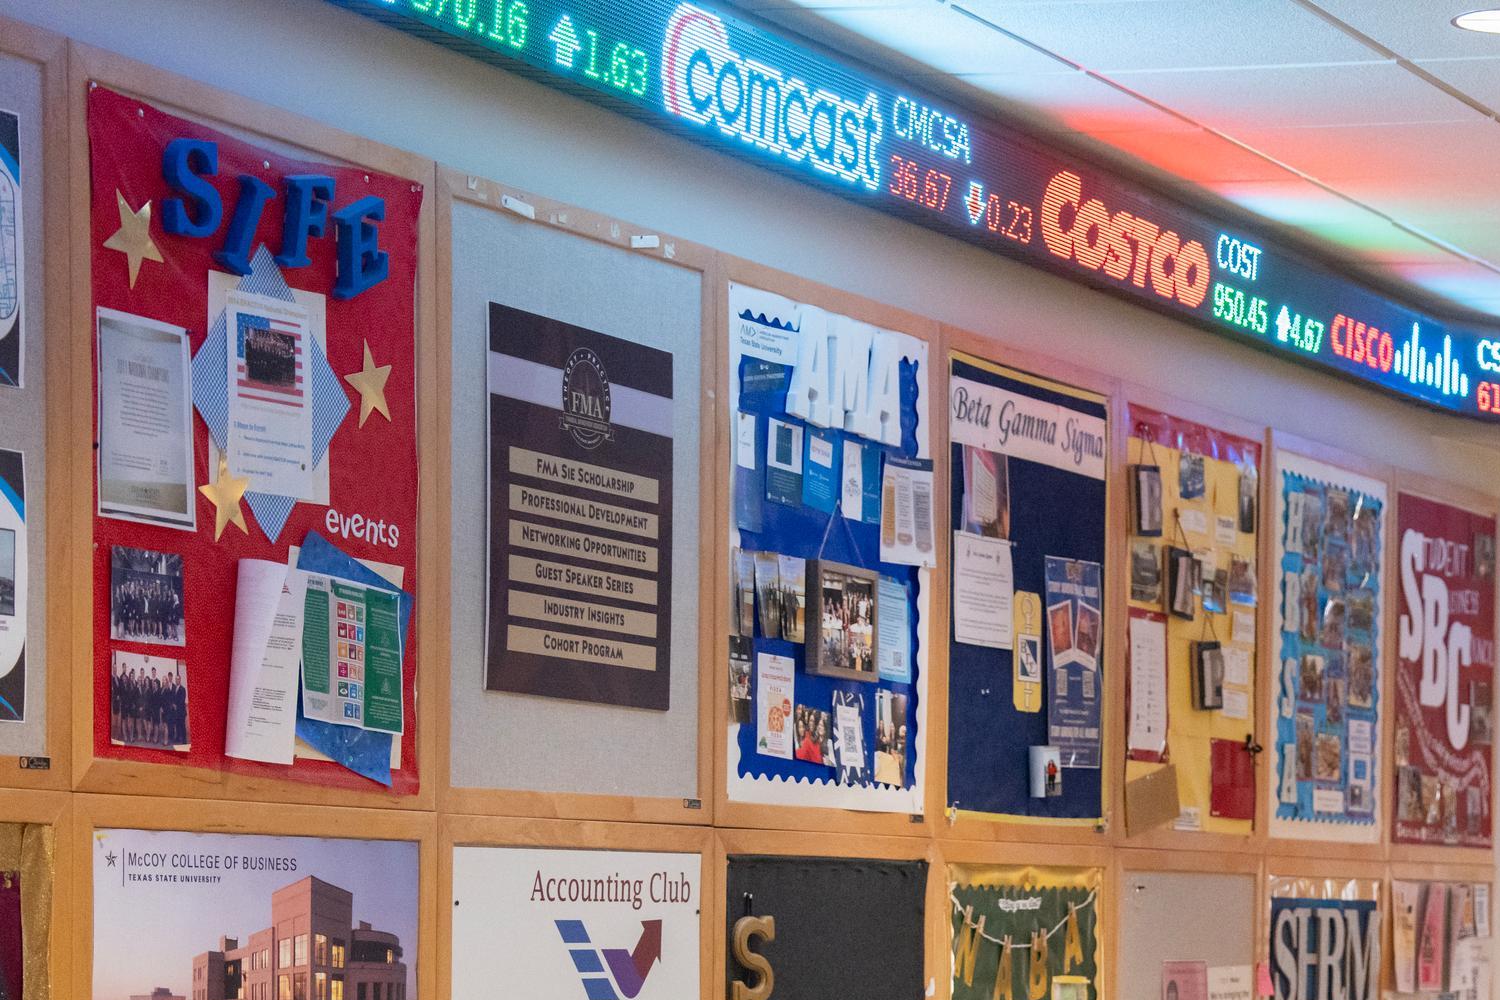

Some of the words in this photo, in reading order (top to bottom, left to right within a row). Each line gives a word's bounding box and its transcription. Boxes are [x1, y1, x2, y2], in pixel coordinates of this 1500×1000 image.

[585, 29, 648, 95] 1.63
[894, 95, 971, 164] CMCSA
[161, 138, 390, 299] SIFE
[890, 155, 952, 211] 36.67
[987, 193, 1032, 244] 0.23
[1217, 234, 1262, 281] COST
[1213, 282, 1268, 334] 950.45
[1289, 315, 1324, 353] 4.67
[1331, 314, 1394, 373] CISCO
[571, 391, 603, 419] FMA
[953, 387, 992, 428] Beta
[1000, 400, 1057, 445] Gamma
[1061, 417, 1103, 465] Sigma
[536, 458, 558, 475] FMA
[577, 468, 635, 494] SCHOLARSHIP
[324, 508, 399, 548] events
[521, 490, 586, 517] PROFESSIONAL
[589, 504, 648, 530] DEVELOPMENT
[522, 526, 581, 551] NETWORKING
[583, 537, 647, 563] OPPORTUNITIES
[535, 563, 562, 582] GUEST
[565, 569, 603, 589] SPEAKER
[606, 577, 634, 594] SERIES
[544, 600, 584, 620] INDUSTRY
[588, 607, 625, 627] INSIGHTS
[544, 634, 579, 654] COHORT
[582, 640, 623, 660] PROGRAM
[1398, 528, 1472, 750] SBC
[128, 873, 152, 883] TEXAS
[155, 874, 177, 883] STATE
[180, 875, 221, 884] UNIVERSITY
[171, 853, 220, 870] COLLEGE
[224, 856, 238, 870] OF
[243, 857, 297, 872] BUSINESS
[530, 870, 643, 910] Accounting
[650, 872, 690, 903] Club
